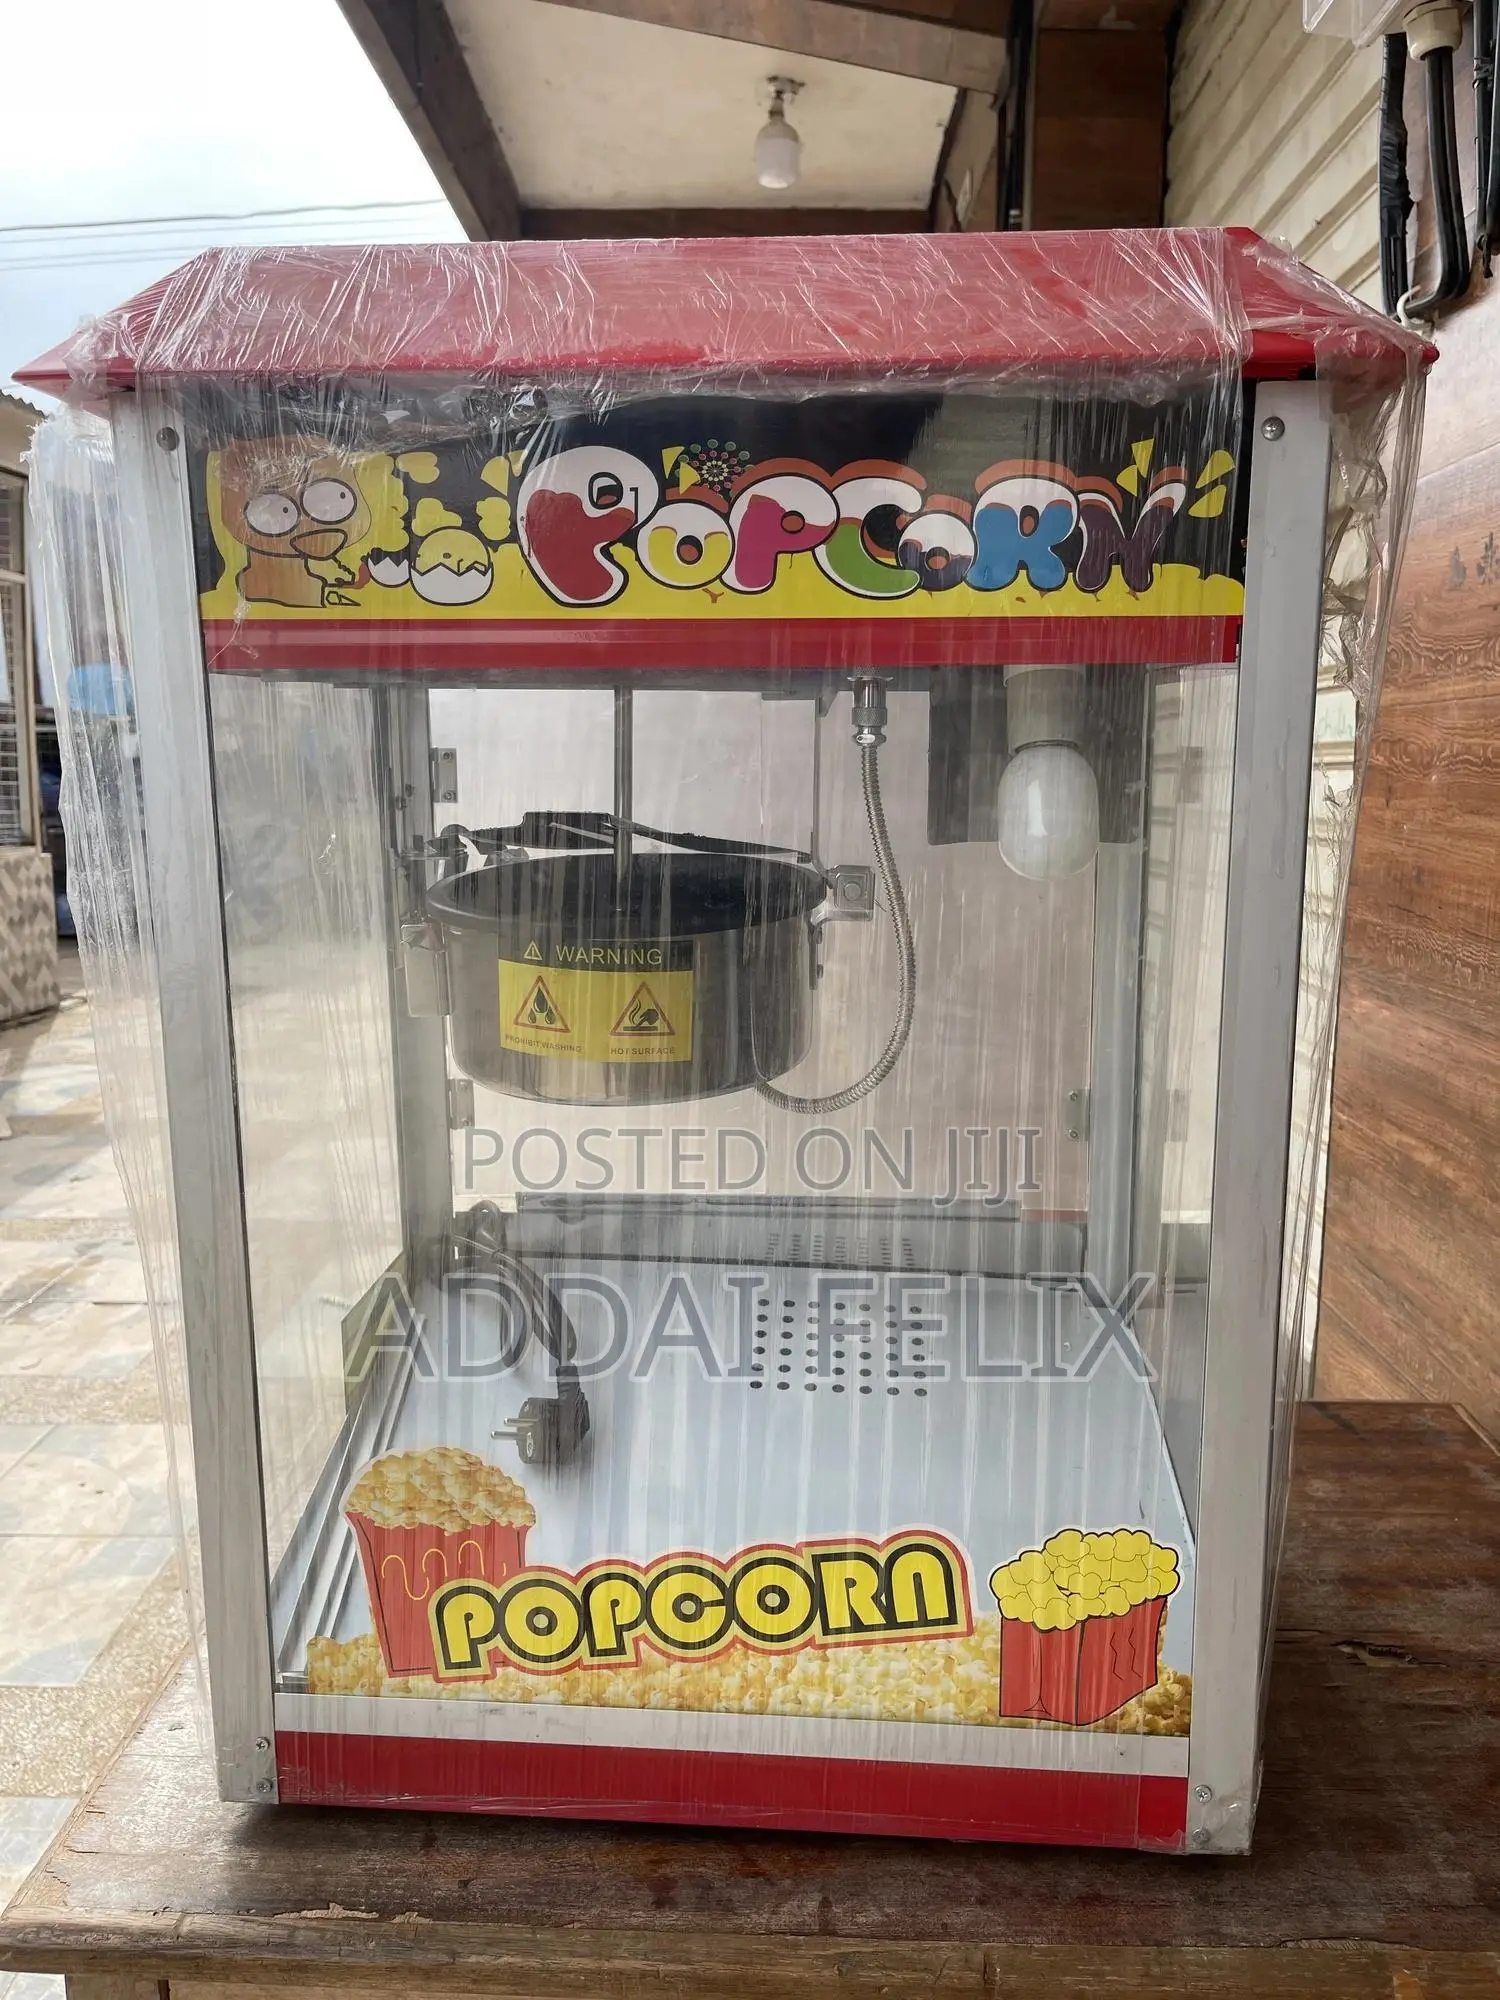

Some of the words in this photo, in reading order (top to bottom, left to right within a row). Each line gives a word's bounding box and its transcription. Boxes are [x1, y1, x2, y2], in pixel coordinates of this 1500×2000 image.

[556, 945, 662, 965] WARNING
[541, 1041, 582, 1053] WASHING
[610, 1046, 629, 1056] HOT
[631, 1046, 676, 1056] SURFACE
[436, 1544, 960, 1671] POPCORN
